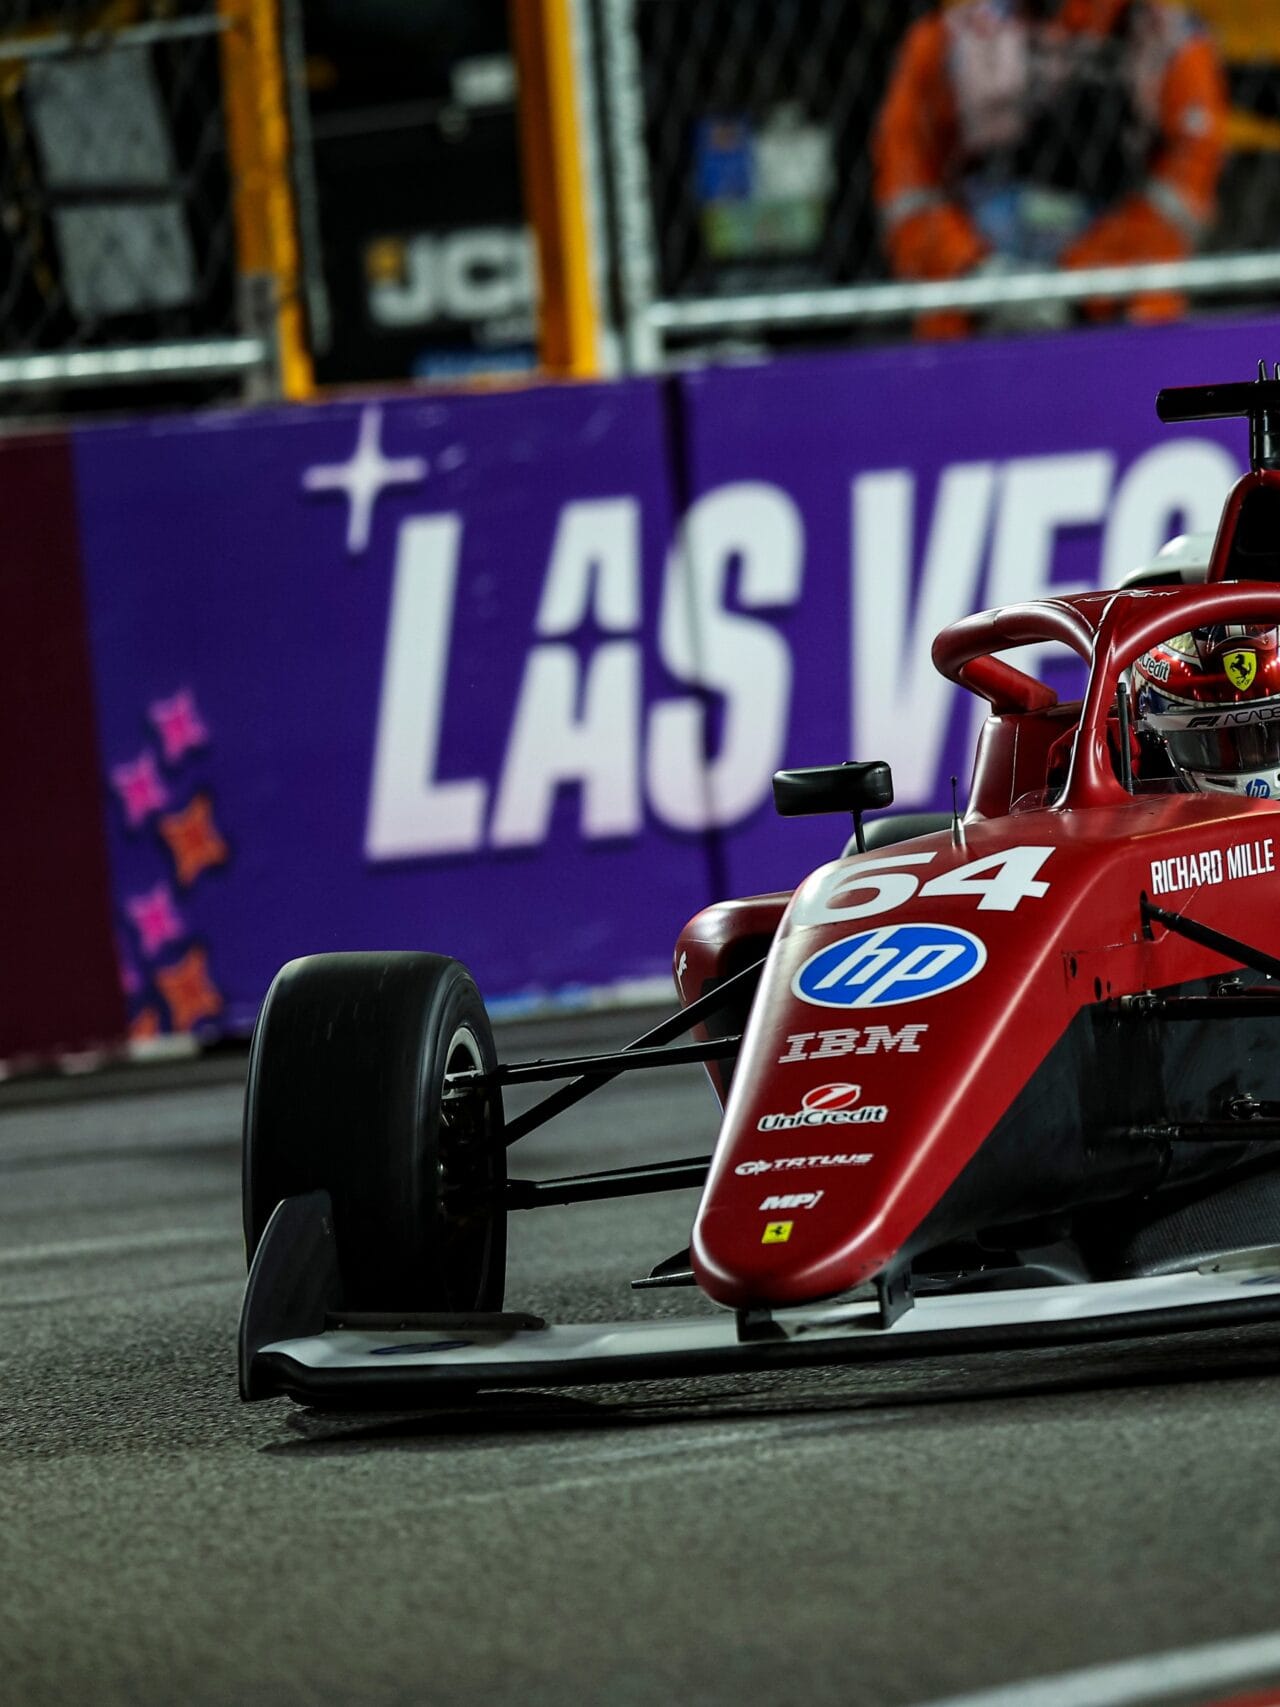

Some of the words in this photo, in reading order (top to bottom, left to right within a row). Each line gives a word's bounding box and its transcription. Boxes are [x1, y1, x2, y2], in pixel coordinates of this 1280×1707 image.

[364, 478, 806, 864] LAS
[1248, 778, 1270, 799] hp
[789, 845, 1056, 926] 64
[1150, 849, 1224, 896] RICHARD
[1226, 838, 1276, 881] MILLE
[809, 926, 970, 1008] hp
[778, 1023, 929, 1064] IBM
[757, 1104, 889, 1132] UniCredit
